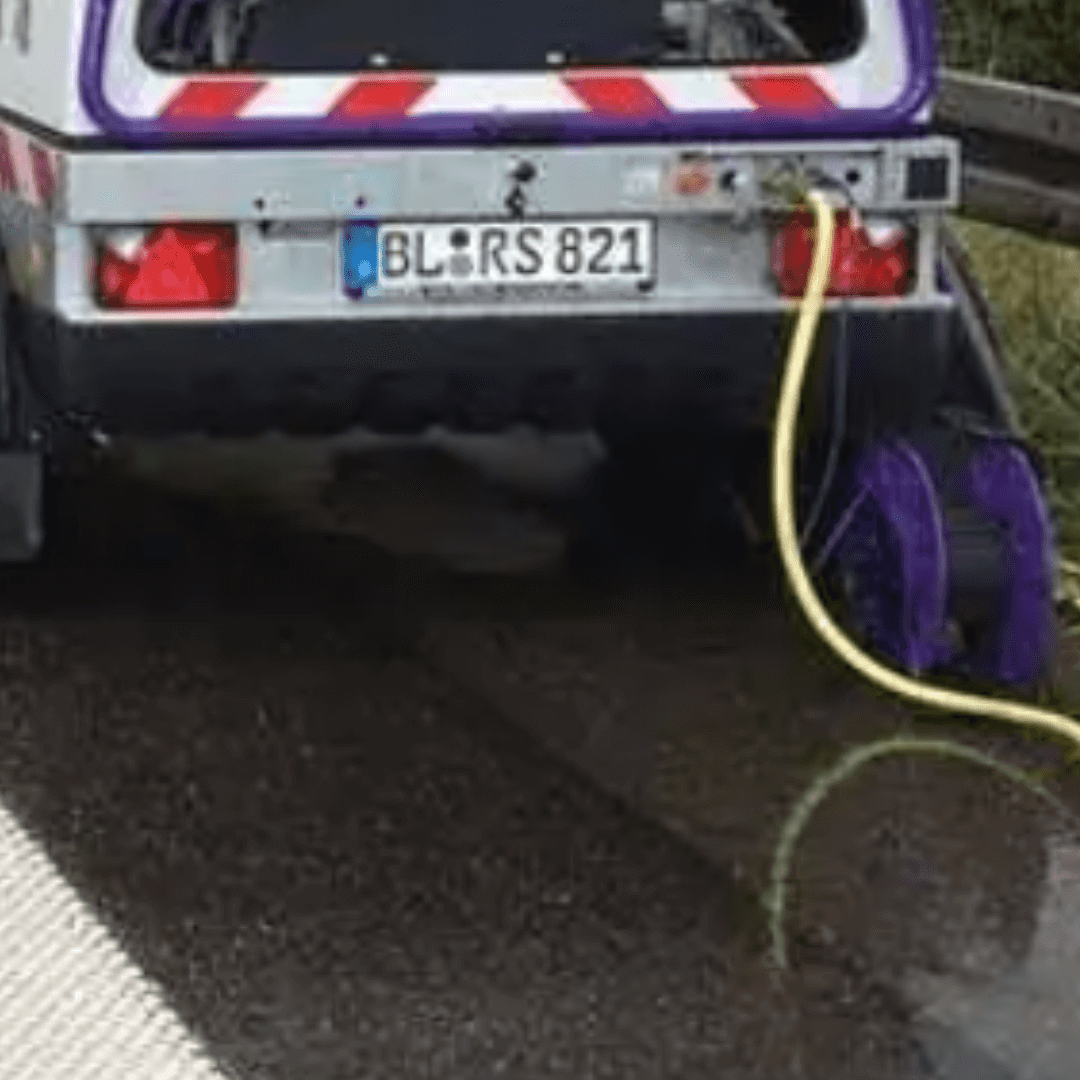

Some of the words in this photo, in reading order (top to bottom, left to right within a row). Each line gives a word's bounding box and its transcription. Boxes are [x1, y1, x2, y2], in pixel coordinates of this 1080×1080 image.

[384, 229, 444, 278] BL
[481, 227, 542, 275] RS
[556, 226, 643, 274] 821
